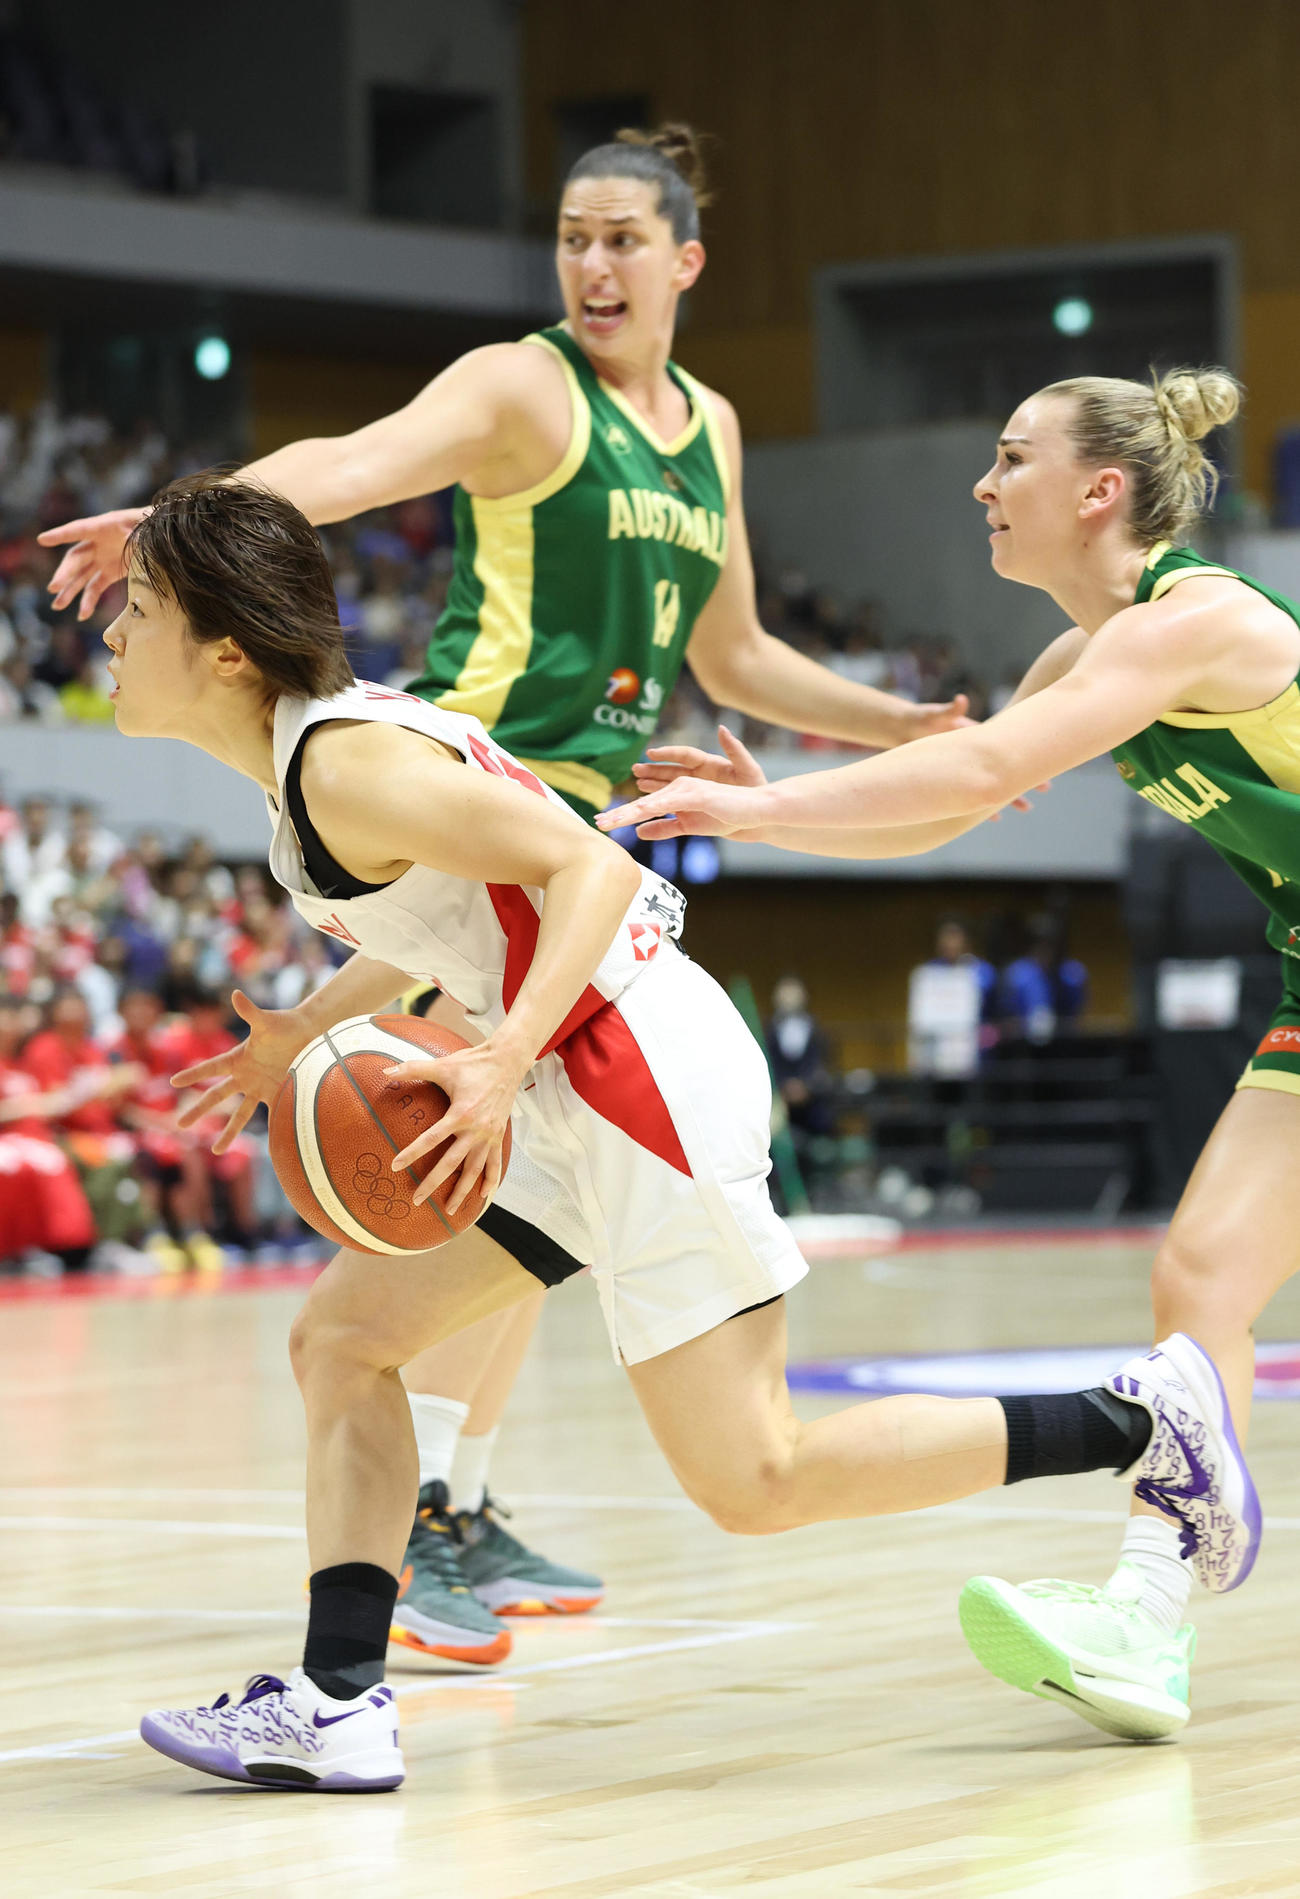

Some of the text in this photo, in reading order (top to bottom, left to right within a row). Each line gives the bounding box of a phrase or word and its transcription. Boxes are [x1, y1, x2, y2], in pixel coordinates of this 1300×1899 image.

[1195, 1513, 1206, 1530] 8
[241, 1727, 261, 1744] 8
[263, 1727, 283, 1746] 8
